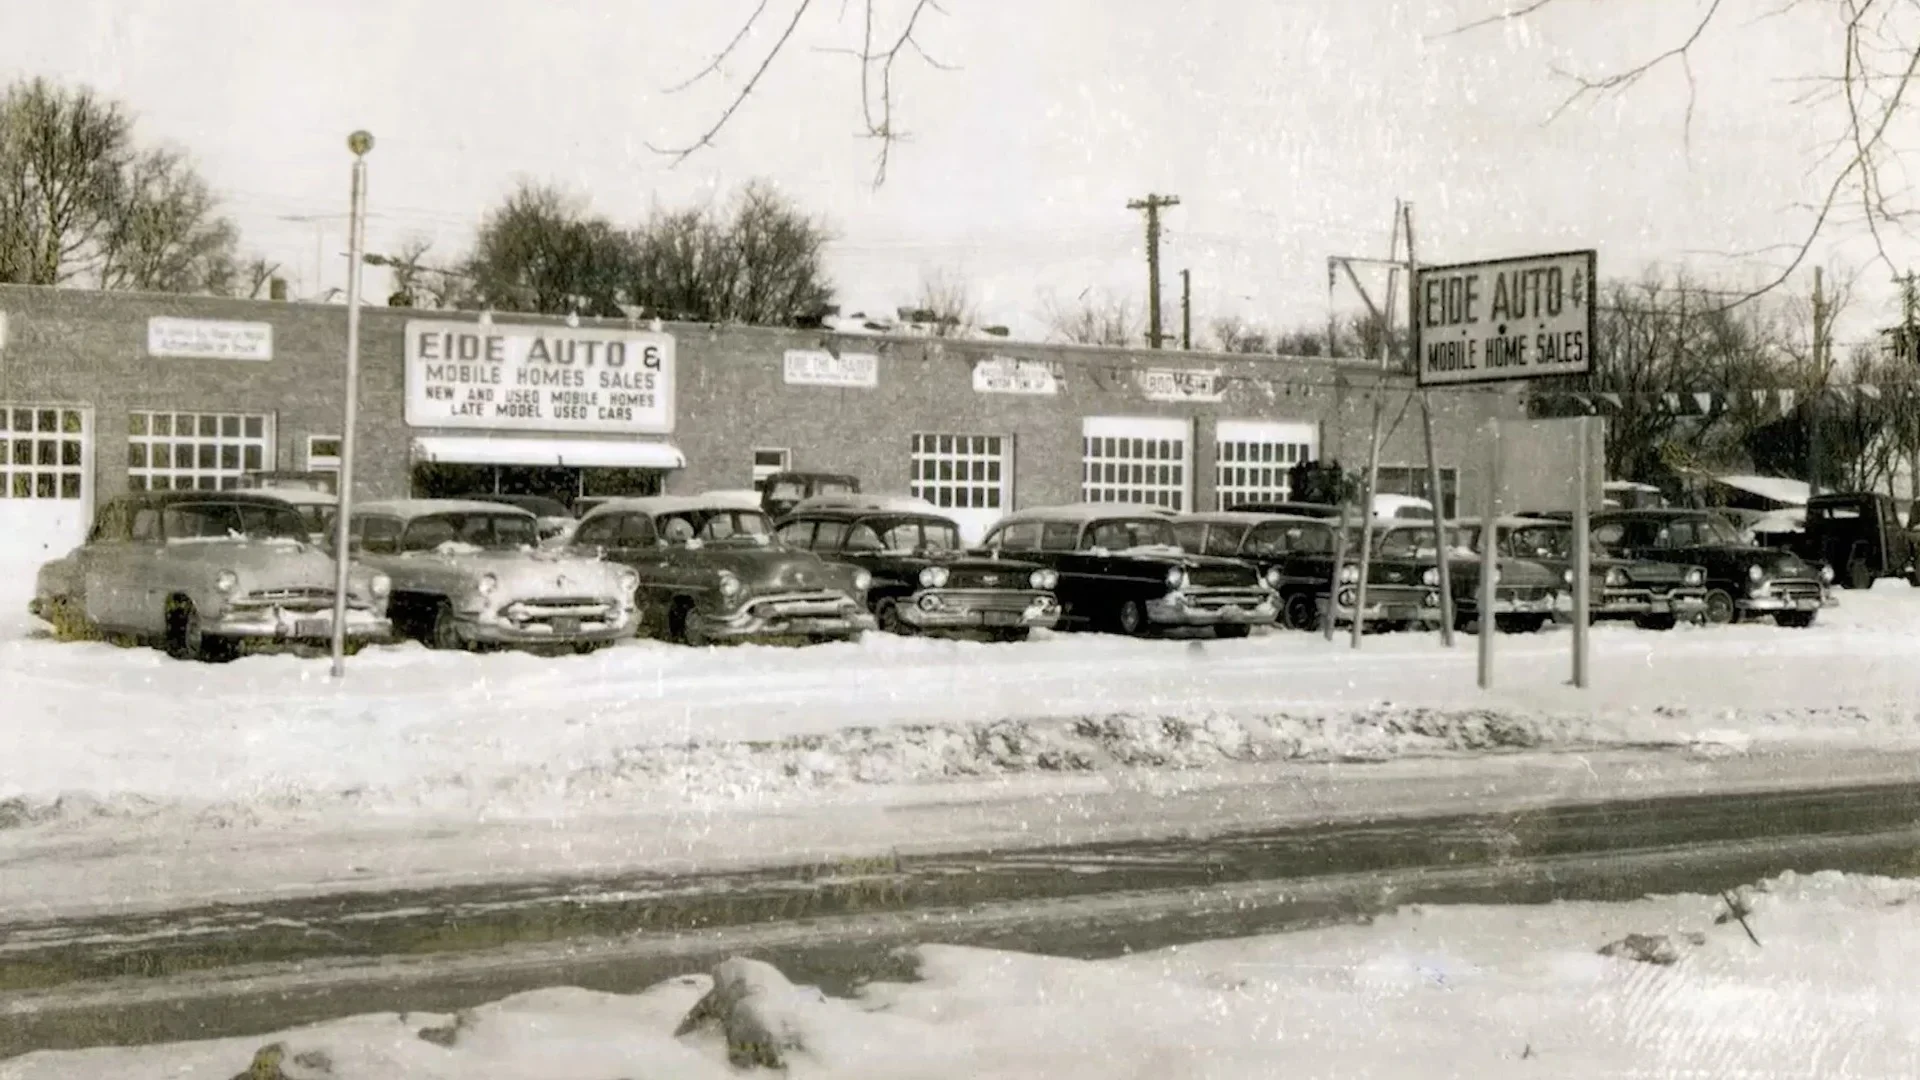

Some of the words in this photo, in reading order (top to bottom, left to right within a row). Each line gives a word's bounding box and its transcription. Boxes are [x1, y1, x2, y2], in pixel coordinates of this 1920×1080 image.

[1426, 275, 1479, 327] EIDE
[1491, 266, 1562, 322] AUTO
[419, 332, 505, 363] EIDE
[528, 336, 626, 368] AUTO
[643, 346, 661, 372] &
[1428, 339, 1477, 372] MOBILE
[1485, 335, 1528, 368] HOME
[1536, 330, 1583, 364] SALES
[425, 364, 502, 384] MOBILE
[516, 367, 585, 388] HOMES
[600, 371, 656, 390] SALES
[425, 386, 455, 400] NEW
[468, 388, 495, 402] AND
[506, 388, 541, 404] USED
[551, 391, 599, 406] MOBILE
[609, 393, 656, 408] HOMES
[450, 402, 485, 416] LATE
[496, 404, 543, 418] MODEL
[554, 406, 588, 420] USED
[598, 407, 633, 421] CARS
